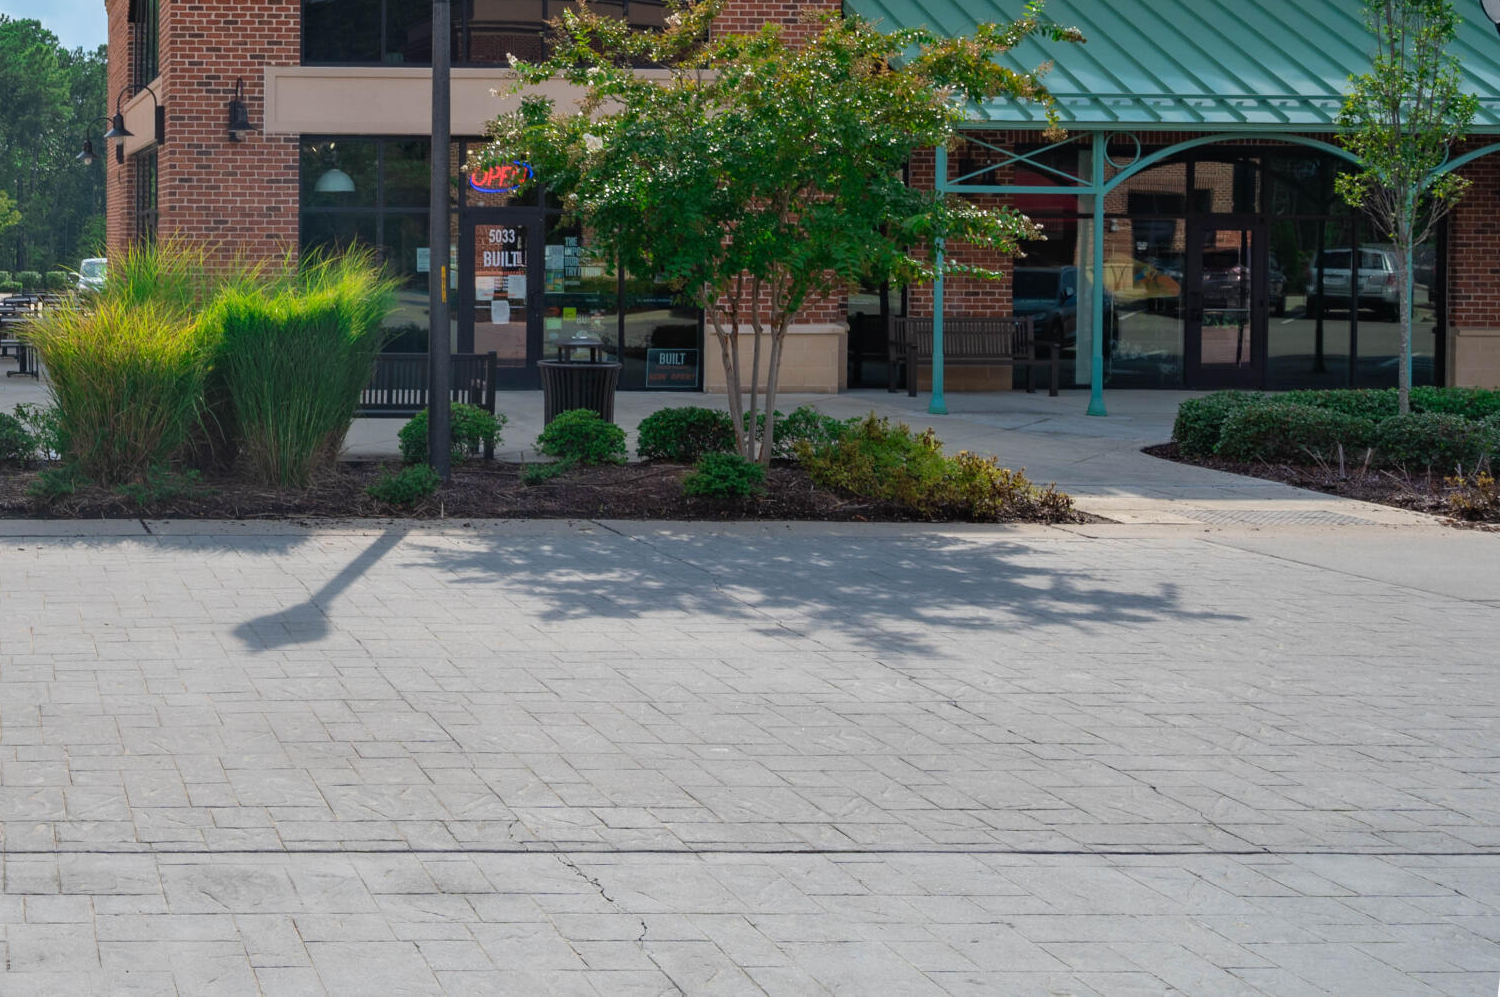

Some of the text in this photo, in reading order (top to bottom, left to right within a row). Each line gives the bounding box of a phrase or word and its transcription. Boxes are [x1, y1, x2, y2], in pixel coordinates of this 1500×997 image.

[488, 229, 516, 244] 5033
[483, 250, 519, 267] BUILT
[659, 352, 686, 365] BUILT
